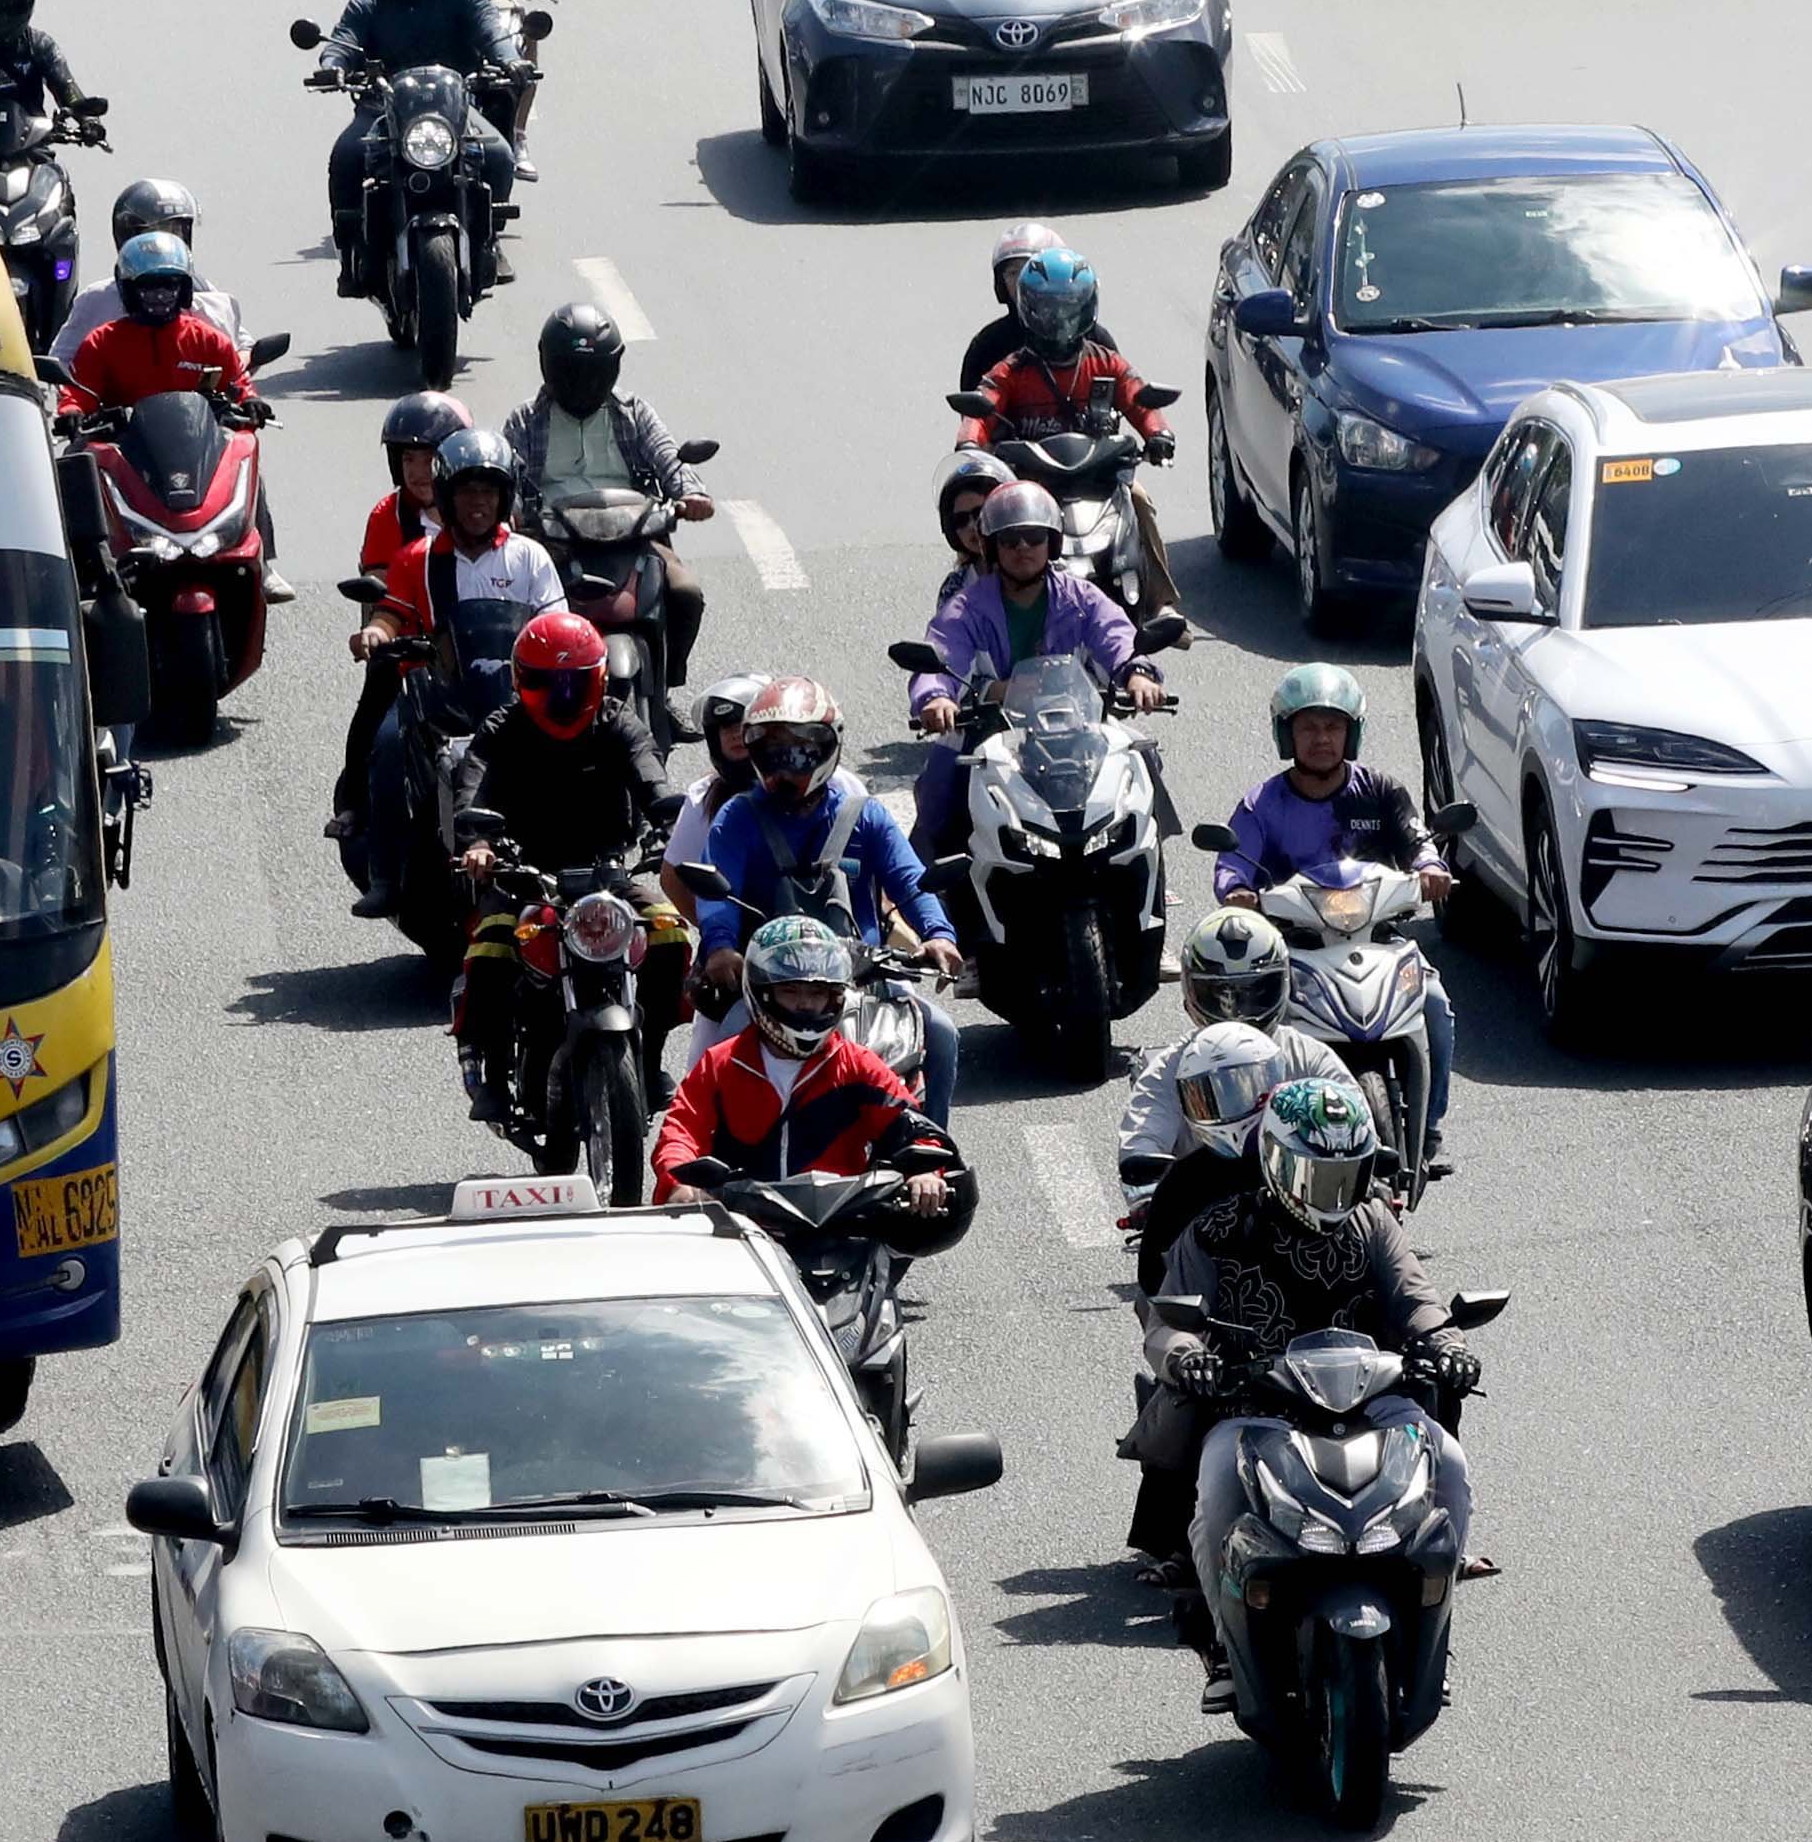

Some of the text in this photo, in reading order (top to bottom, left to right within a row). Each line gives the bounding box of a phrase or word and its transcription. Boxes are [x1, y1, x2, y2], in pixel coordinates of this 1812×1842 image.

[971, 83, 1069, 106] NJC 8069
[1350, 818, 1381, 831] DENNIS
[477, 1185, 567, 1209] TAXI
[531, 1804, 695, 1842] UWD 248
